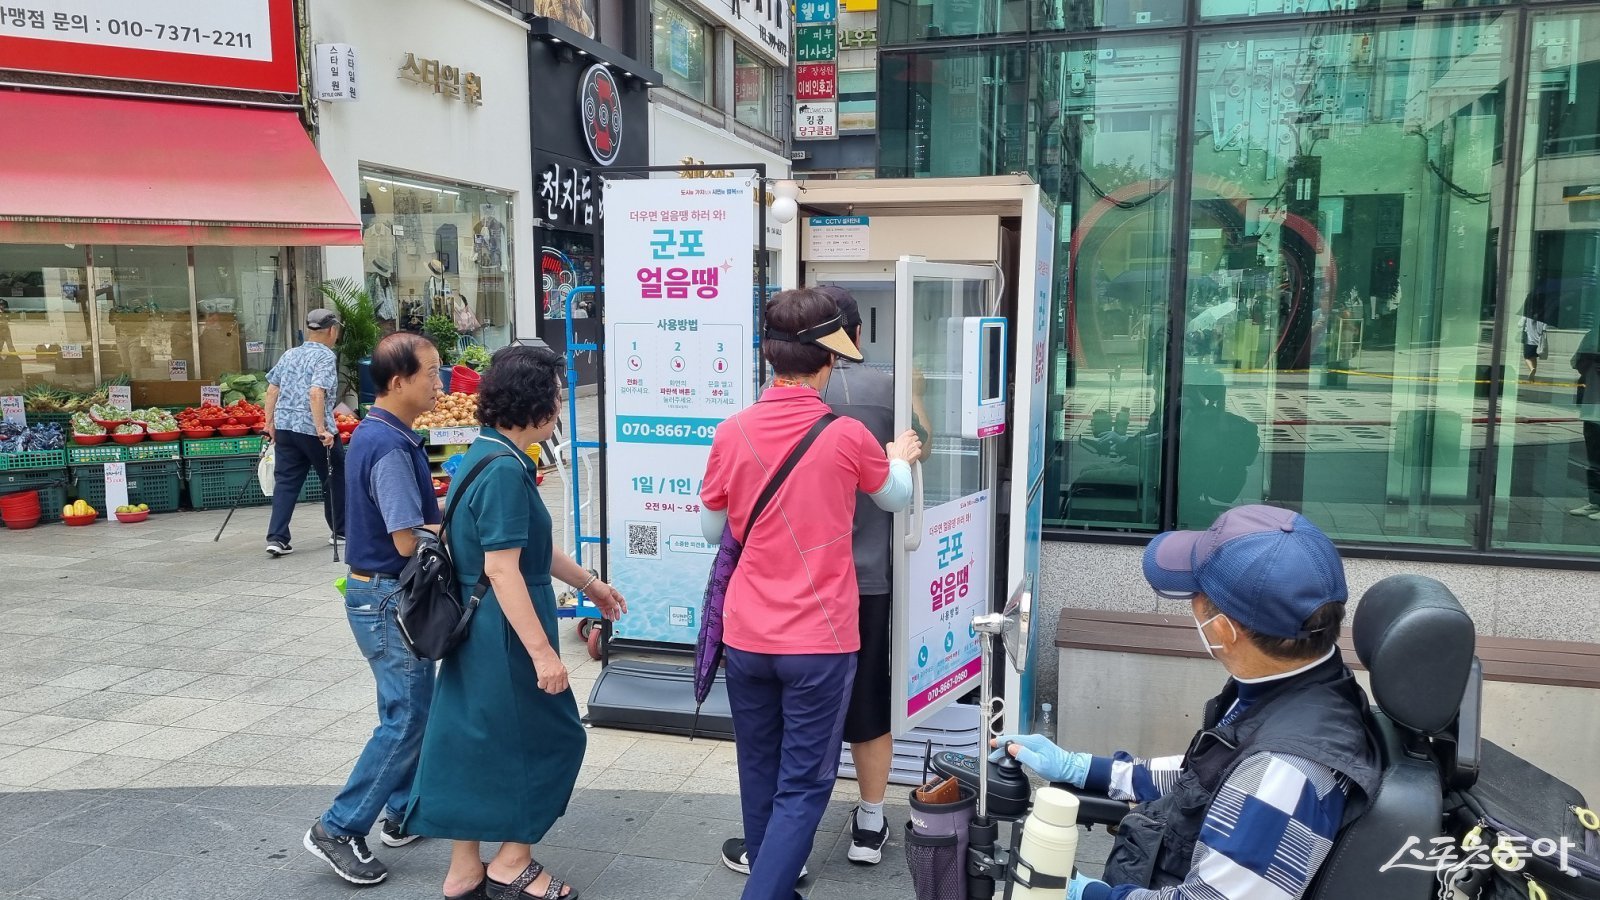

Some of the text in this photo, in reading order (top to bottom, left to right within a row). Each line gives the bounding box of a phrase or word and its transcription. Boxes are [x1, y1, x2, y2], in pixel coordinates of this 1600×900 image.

[52, 12, 88, 33] 문의
[107, 18, 252, 48] 010-7371-2211
[799, 44, 834, 59] 미사랑
[398, 52, 460, 99] 스타일
[798, 66, 806, 74] 3F
[331, 80, 340, 91] 원
[798, 79, 834, 96] 이비인후과
[799, 125, 833, 136] 당구클럽
[541, 163, 604, 226] 전자담
[629, 209, 726, 222] 더우면 얼음땡 하러 와!
[650, 229, 705, 259] 군포
[637, 266, 719, 299] 얼음땡
[657, 319, 698, 331] 사용방법
[632, 341, 637, 350] 1
[674, 341, 681, 351] 2
[717, 342, 724, 352] 3
[621, 422, 716, 438] 070-8667-09
[632, 476, 653, 494] 1일
[669, 477, 691, 495] 1인
[644, 502, 660, 511] 오전
[662, 503, 675, 512] 9시
[684, 503, 700, 513] 오후
[937, 531, 964, 569] 군포
[930, 564, 970, 612] 얼음땡
[927, 669, 968, 702] 070-8667-0980
